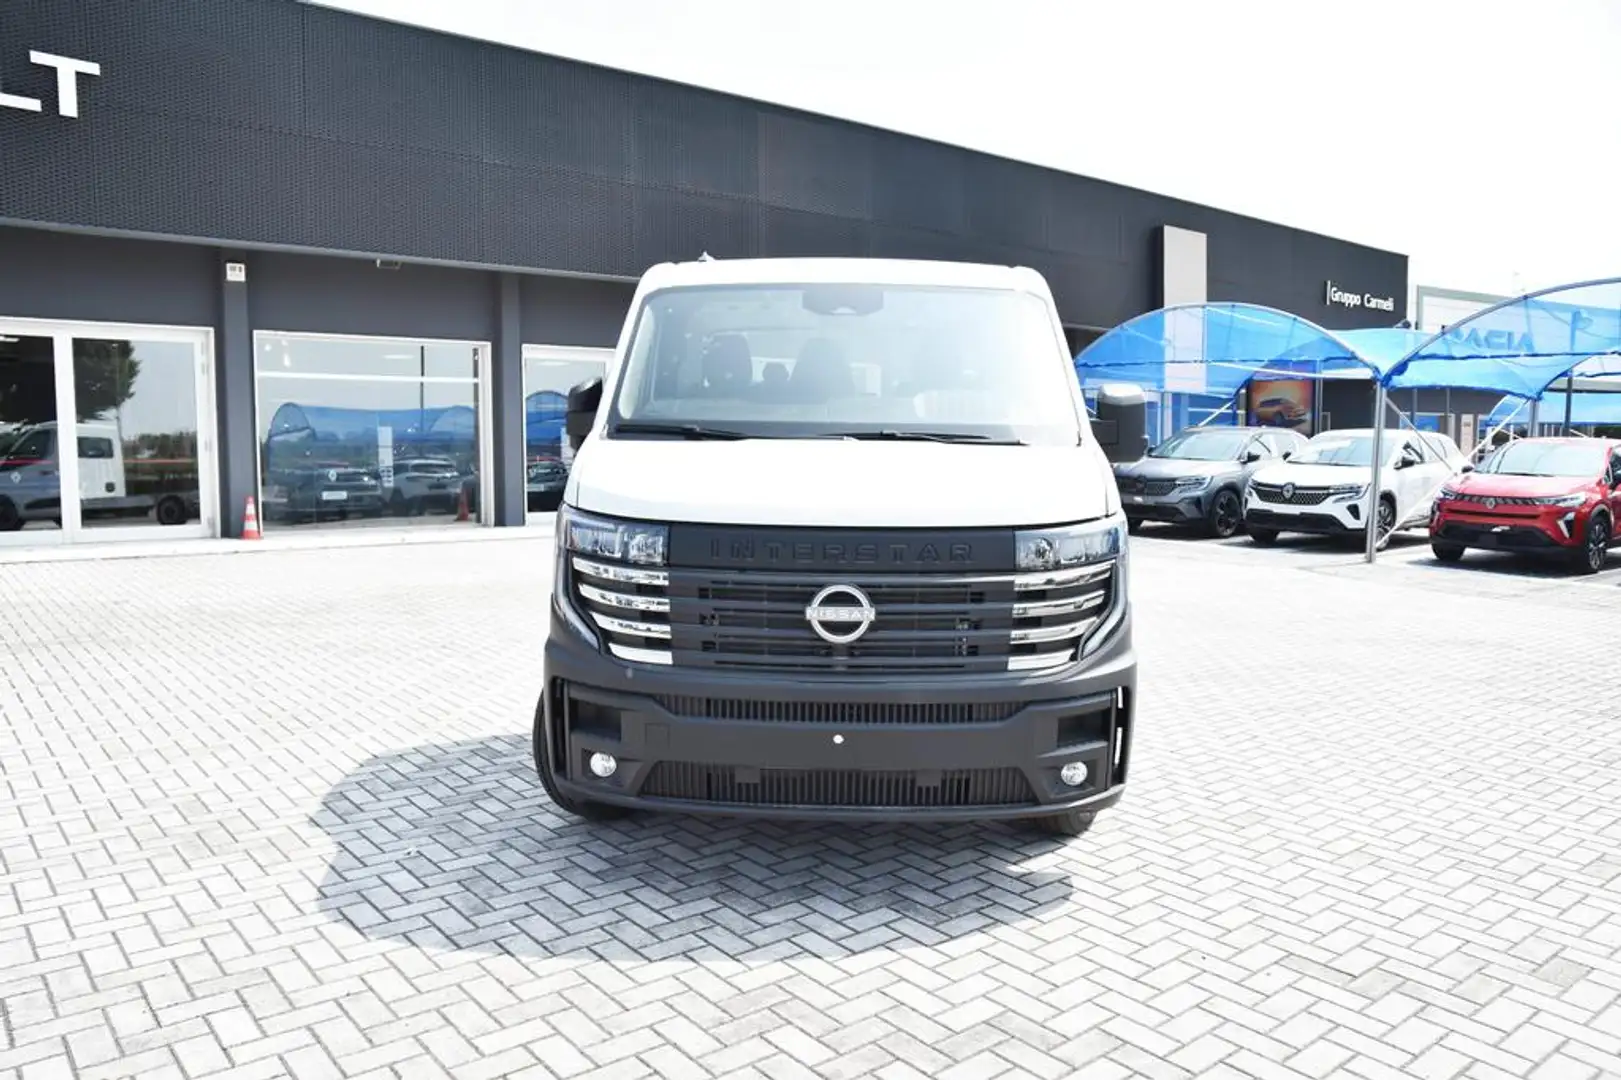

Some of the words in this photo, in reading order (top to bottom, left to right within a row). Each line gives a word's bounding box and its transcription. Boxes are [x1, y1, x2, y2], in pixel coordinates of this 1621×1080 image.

[1331, 287, 1361, 307] Gruppo
[710, 540, 974, 564] INTERSTAR
[806, 607, 875, 621] NISSAN
